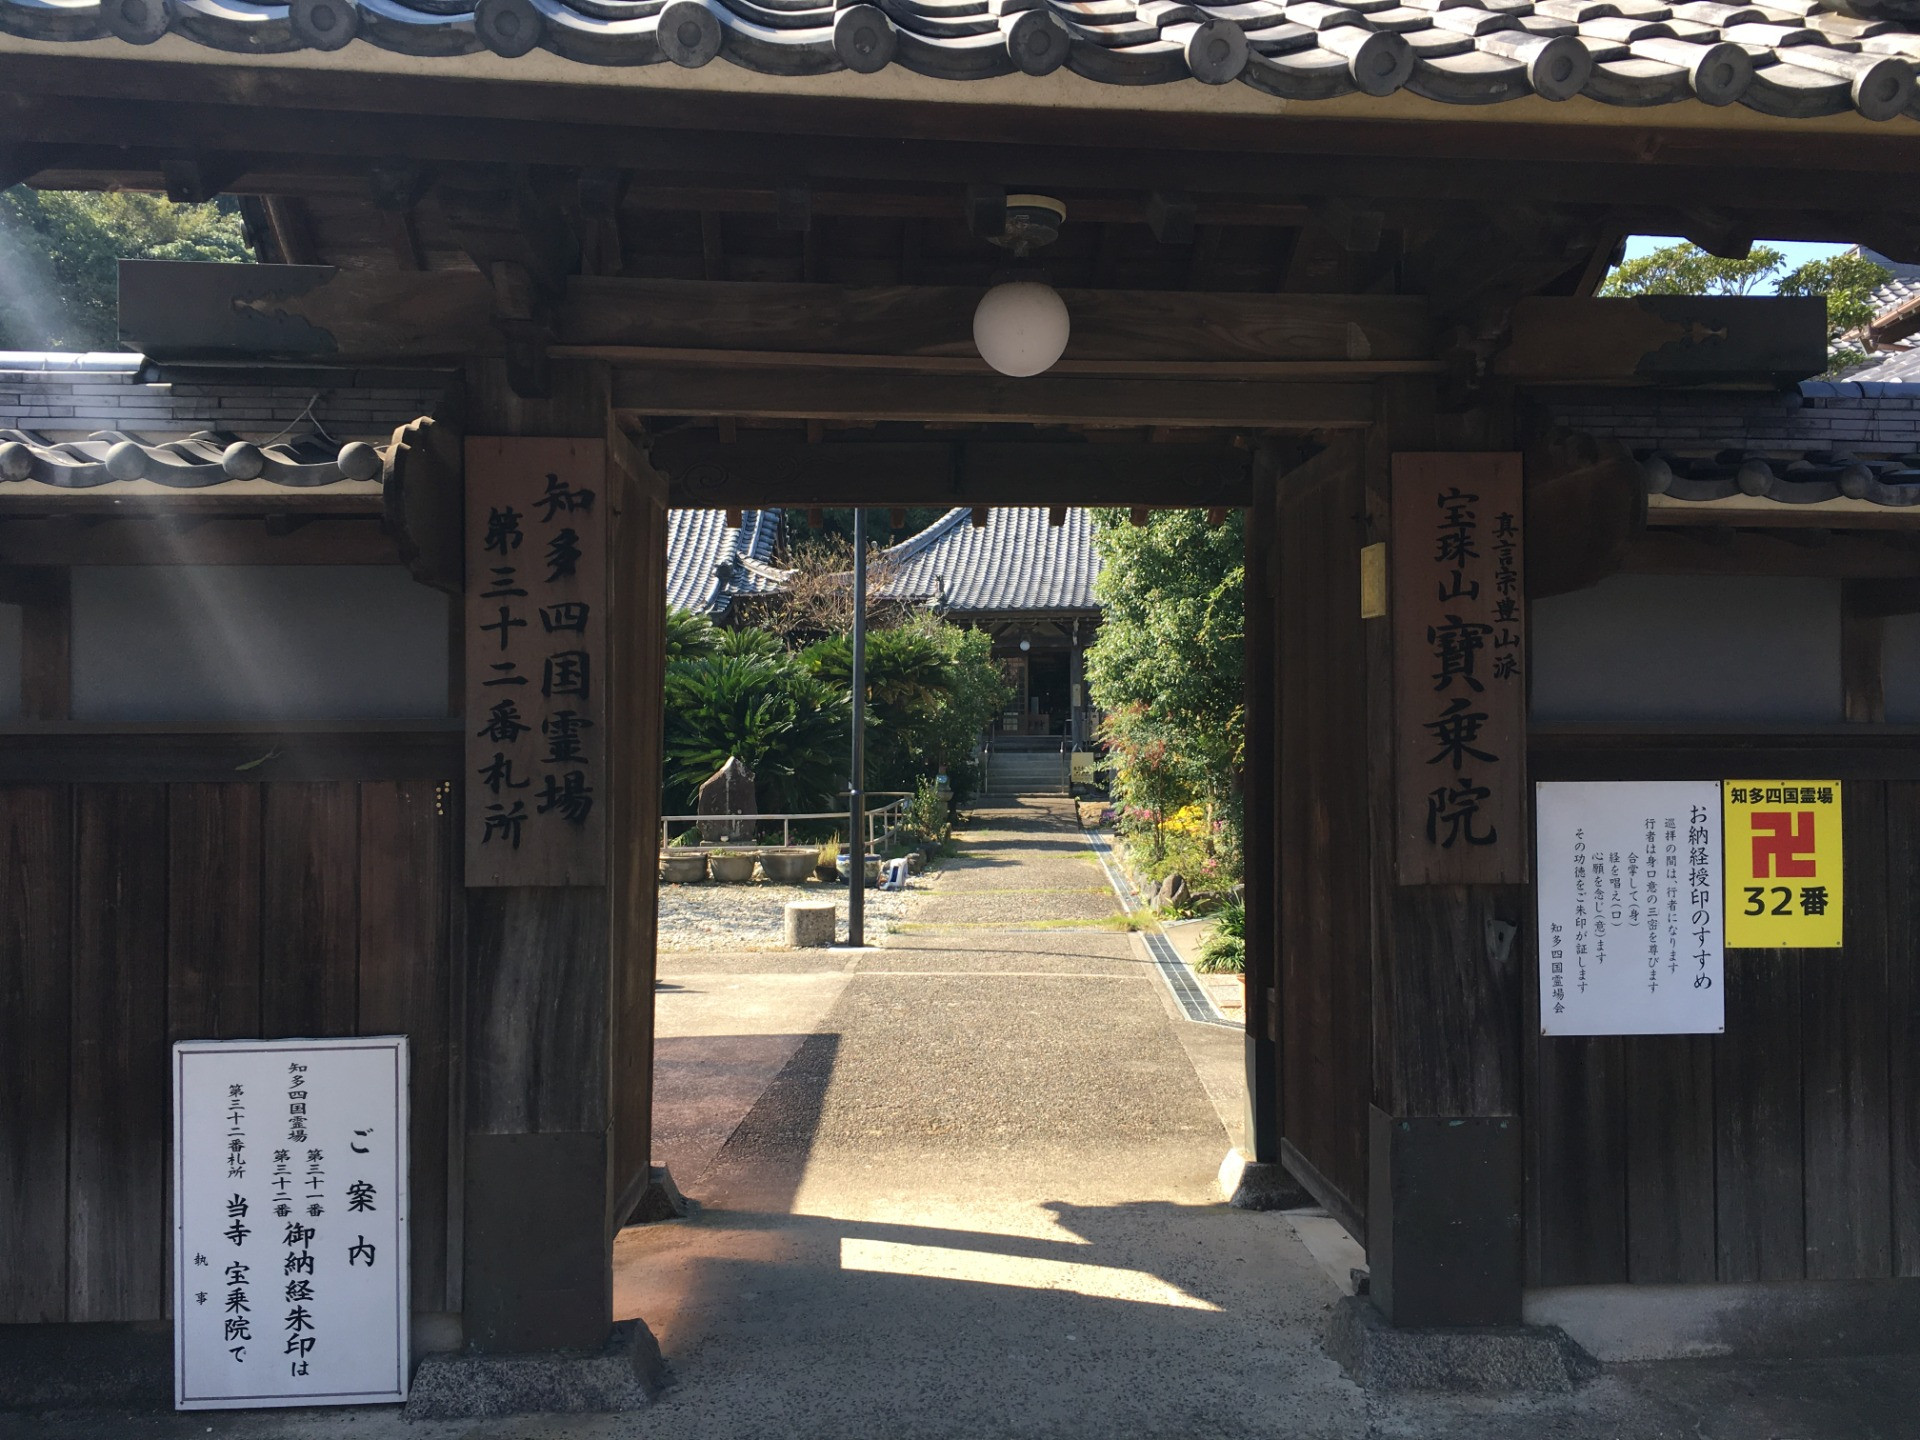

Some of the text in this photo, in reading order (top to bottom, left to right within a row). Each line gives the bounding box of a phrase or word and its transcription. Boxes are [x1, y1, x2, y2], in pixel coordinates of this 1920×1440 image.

[532, 473, 595, 827] 知多四国霊場
[1491, 512, 1520, 679] 真言宗豊山派
[477, 507, 531, 850] 第三十二番札所
[1731, 788, 1833, 804] 知多四国霊場
[1550, 921, 1565, 1013] 知多四国霊場会
[1573, 828, 1588, 993] その功徳をご朱印が証します
[1644, 818, 1658, 993] 行者は身口意の三密を尊びます
[1664, 817, 1678, 974] 巡拝の間は、行者になります
[1687, 804, 1711, 990] お納経授印のすすめ
[1744, 887, 1828, 916] 32番
[226, 1083, 246, 1179] 第三十二番札所
[287, 1062, 307, 1143] 知多四国霊場
[271, 1148, 292, 1217] 第三十二番
[305, 1148, 325, 1217] 第三十一番
[346, 1128, 377, 1267] ご案内
[282, 1221, 315, 1377] 御納経朱印は
